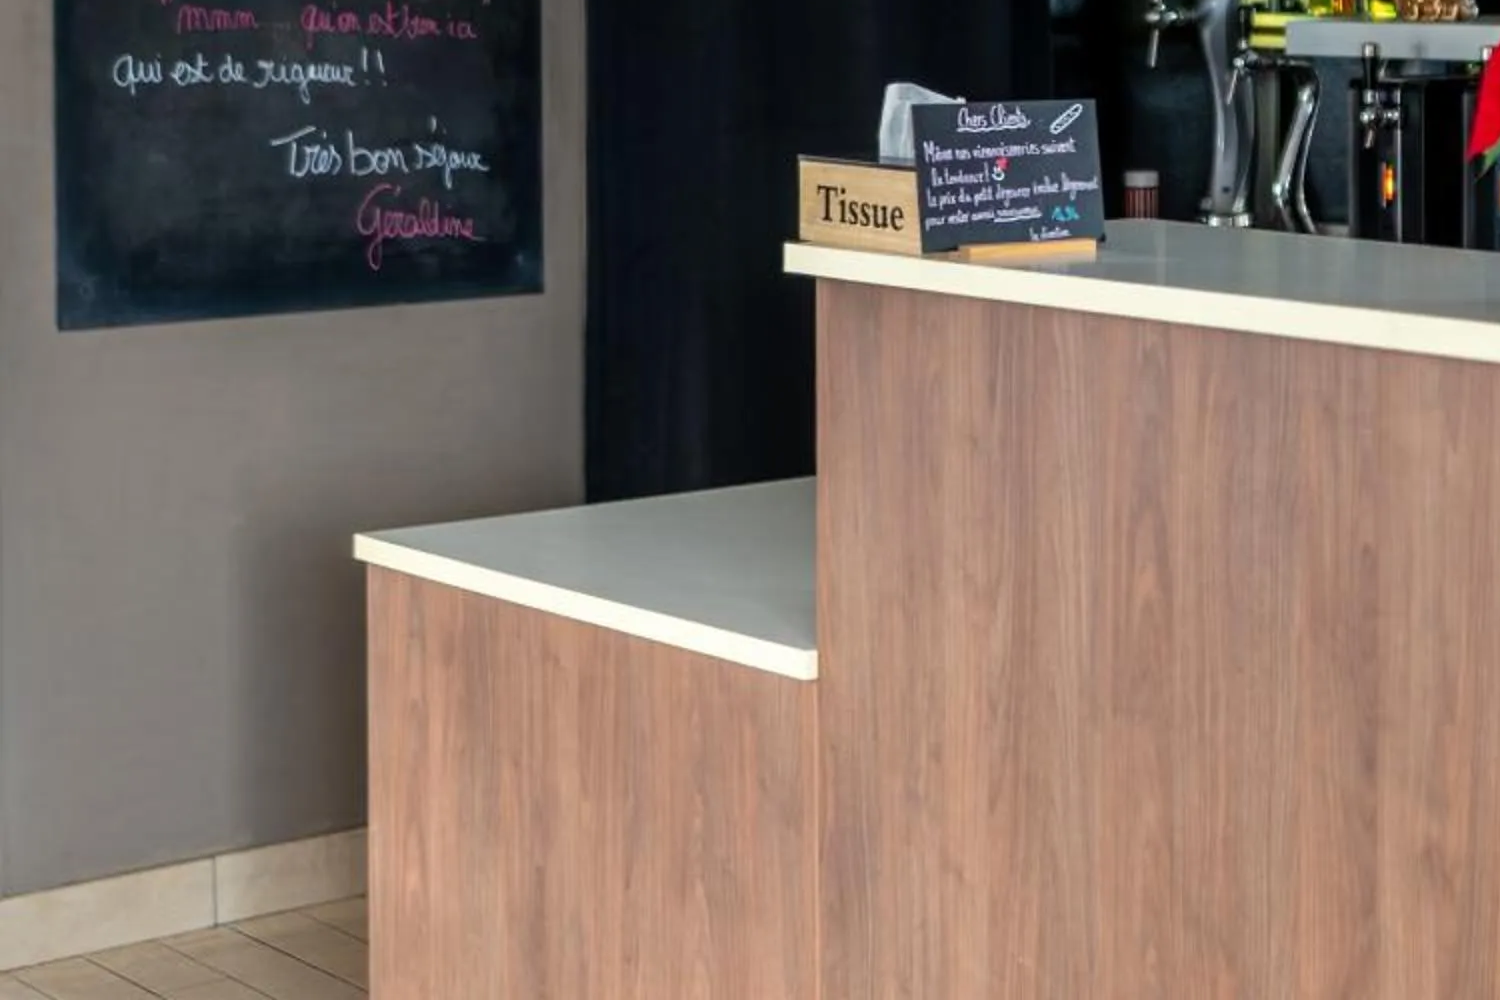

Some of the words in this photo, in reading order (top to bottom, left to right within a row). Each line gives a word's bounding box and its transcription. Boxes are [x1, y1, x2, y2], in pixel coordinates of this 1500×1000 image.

[113, 50, 164, 95] qui
[169, 54, 210, 85] est
[219, 55, 248, 85] de
[269, 126, 343, 178] Très
[348, 131, 409, 177] bon
[414, 117, 492, 188] séjour
[356, 183, 484, 271] Géraldine
[817, 183, 905, 232] Tissue
